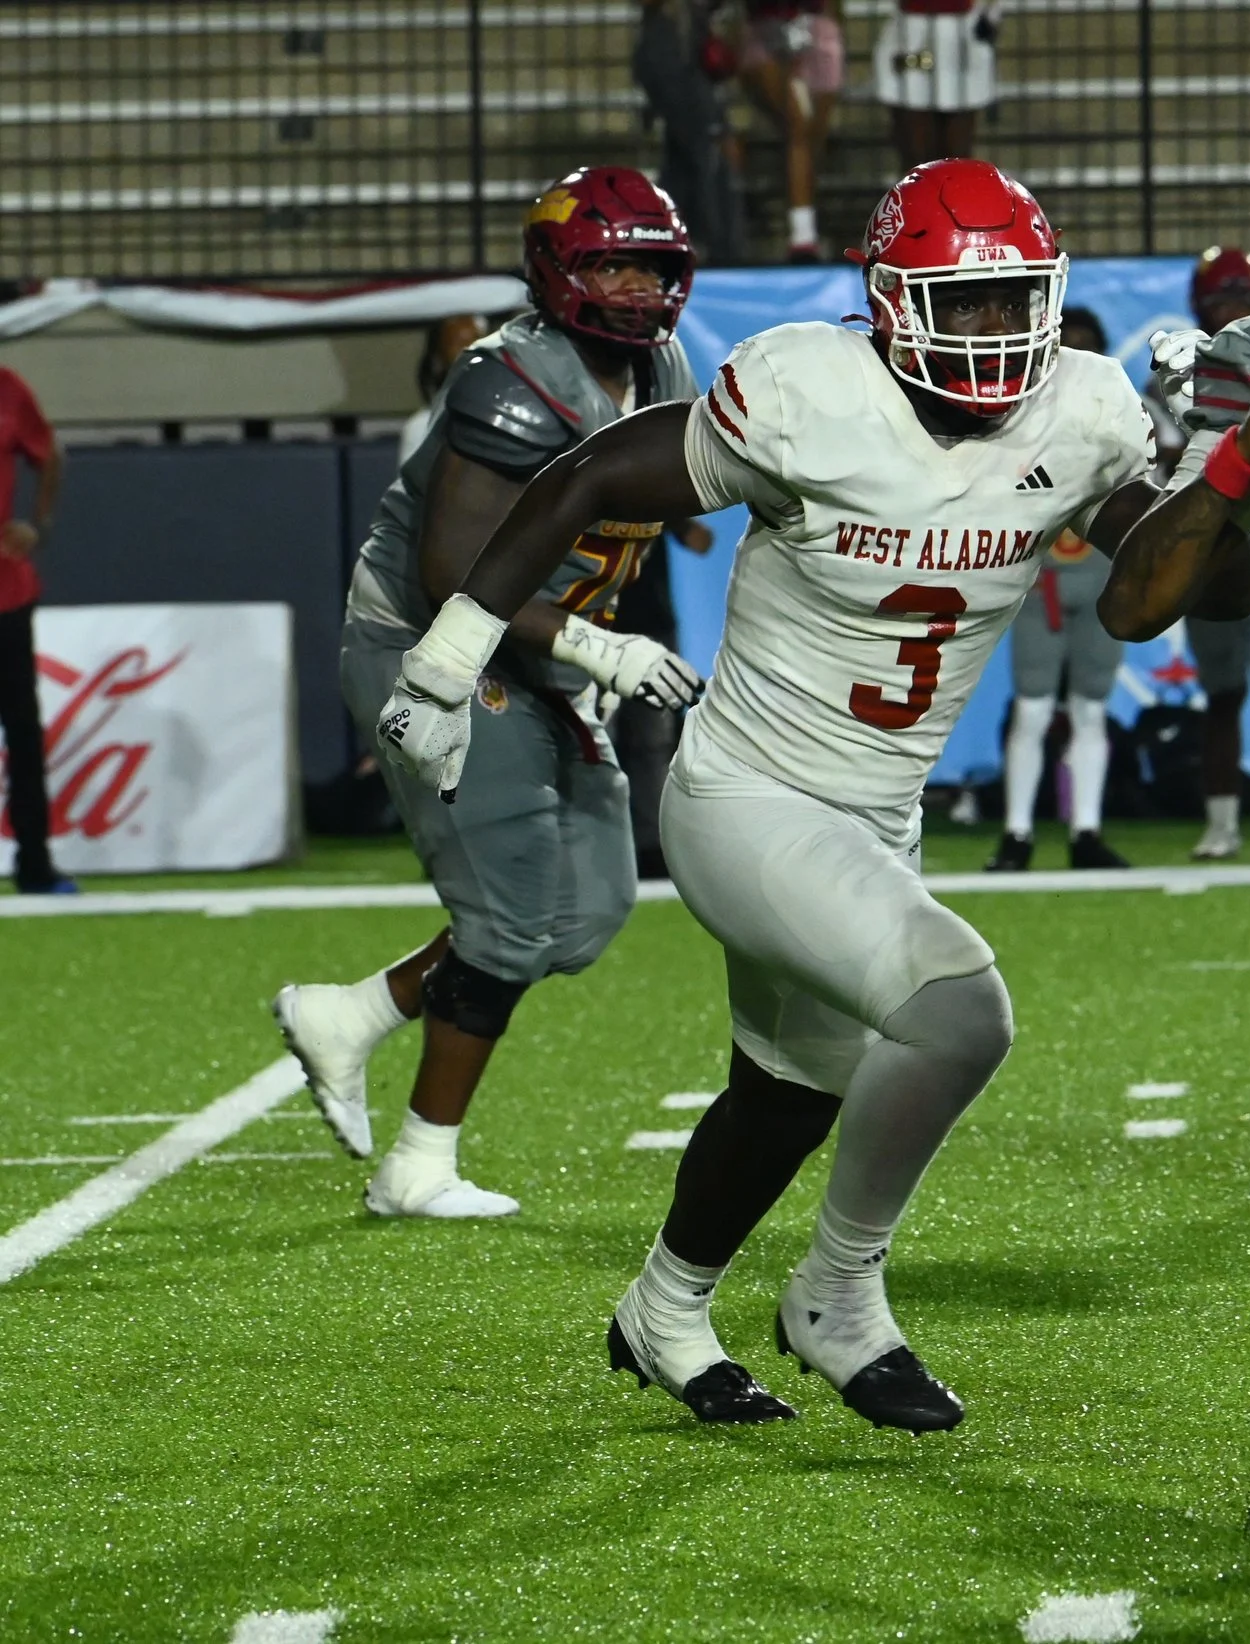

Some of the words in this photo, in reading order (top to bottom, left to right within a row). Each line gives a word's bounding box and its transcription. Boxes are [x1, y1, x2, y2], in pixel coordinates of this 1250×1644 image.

[977, 248, 1007, 262] UWA
[834, 521, 911, 567] WEST
[916, 529, 1045, 571] ALABAMA
[849, 583, 968, 730] 3
